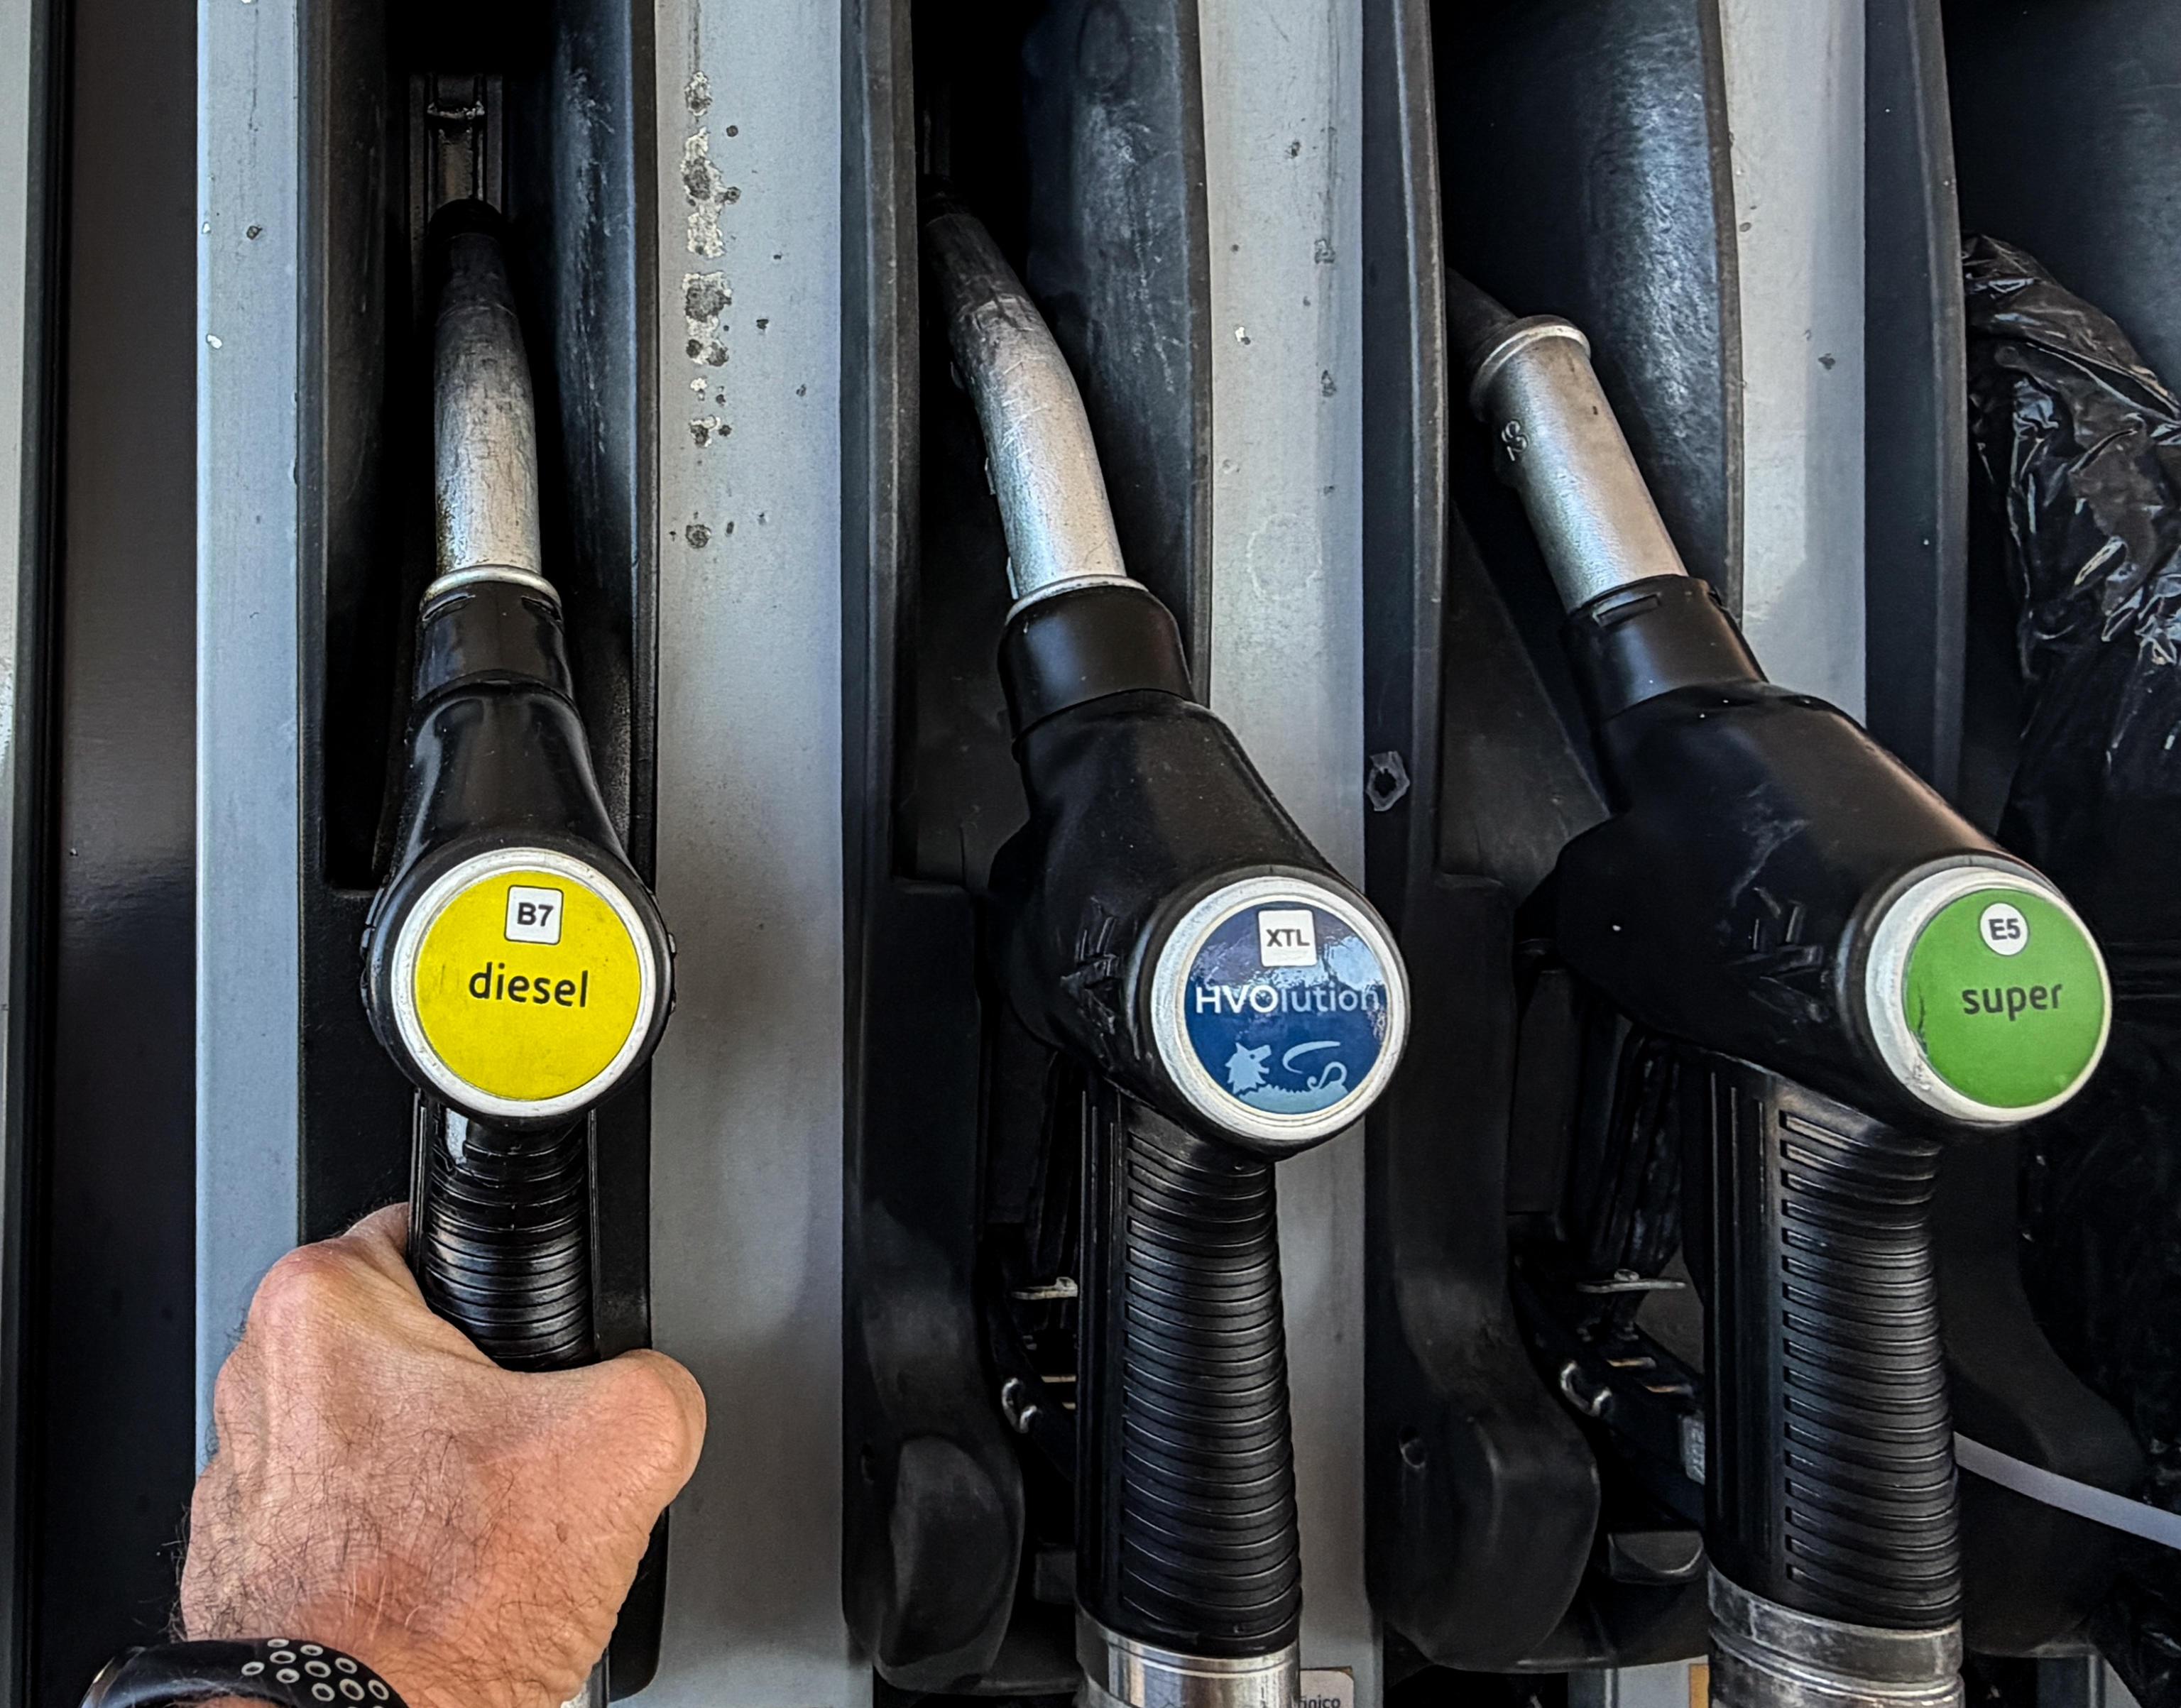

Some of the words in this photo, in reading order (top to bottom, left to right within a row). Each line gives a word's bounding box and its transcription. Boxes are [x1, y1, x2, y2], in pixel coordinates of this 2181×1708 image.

[517, 902, 554, 926] B7
[1266, 929, 1311, 947] XTL
[1988, 918, 2021, 941] E5
[469, 961, 589, 1008] diesel
[1196, 982, 1379, 1014] HVOlution
[1962, 984, 2062, 1022] super
